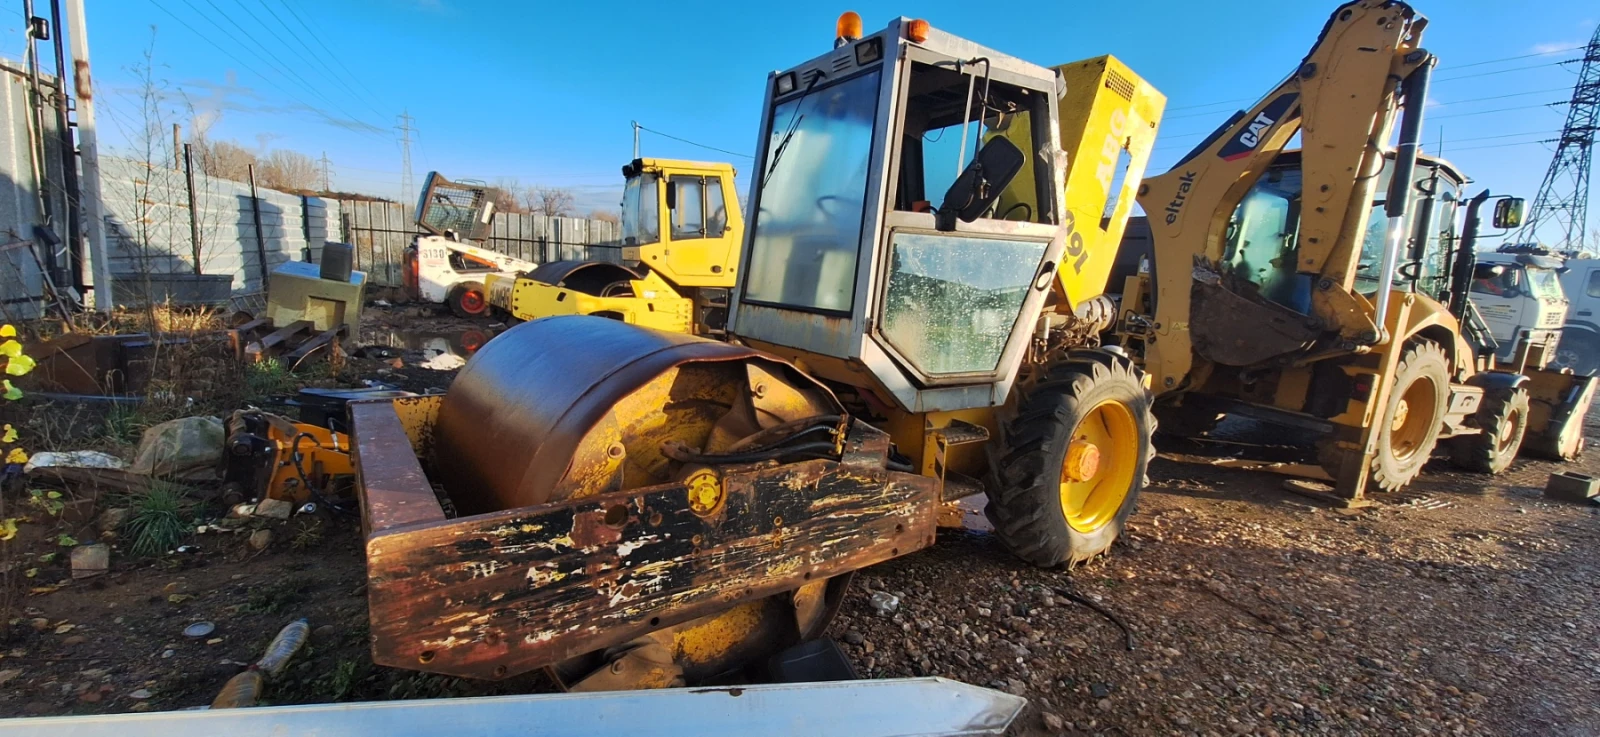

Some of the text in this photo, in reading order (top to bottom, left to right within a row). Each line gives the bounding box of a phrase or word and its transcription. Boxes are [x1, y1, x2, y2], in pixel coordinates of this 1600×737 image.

[1096, 108, 1126, 196] ABG
[1240, 112, 1275, 148] CAT
[1165, 170, 1197, 225] eltrak
